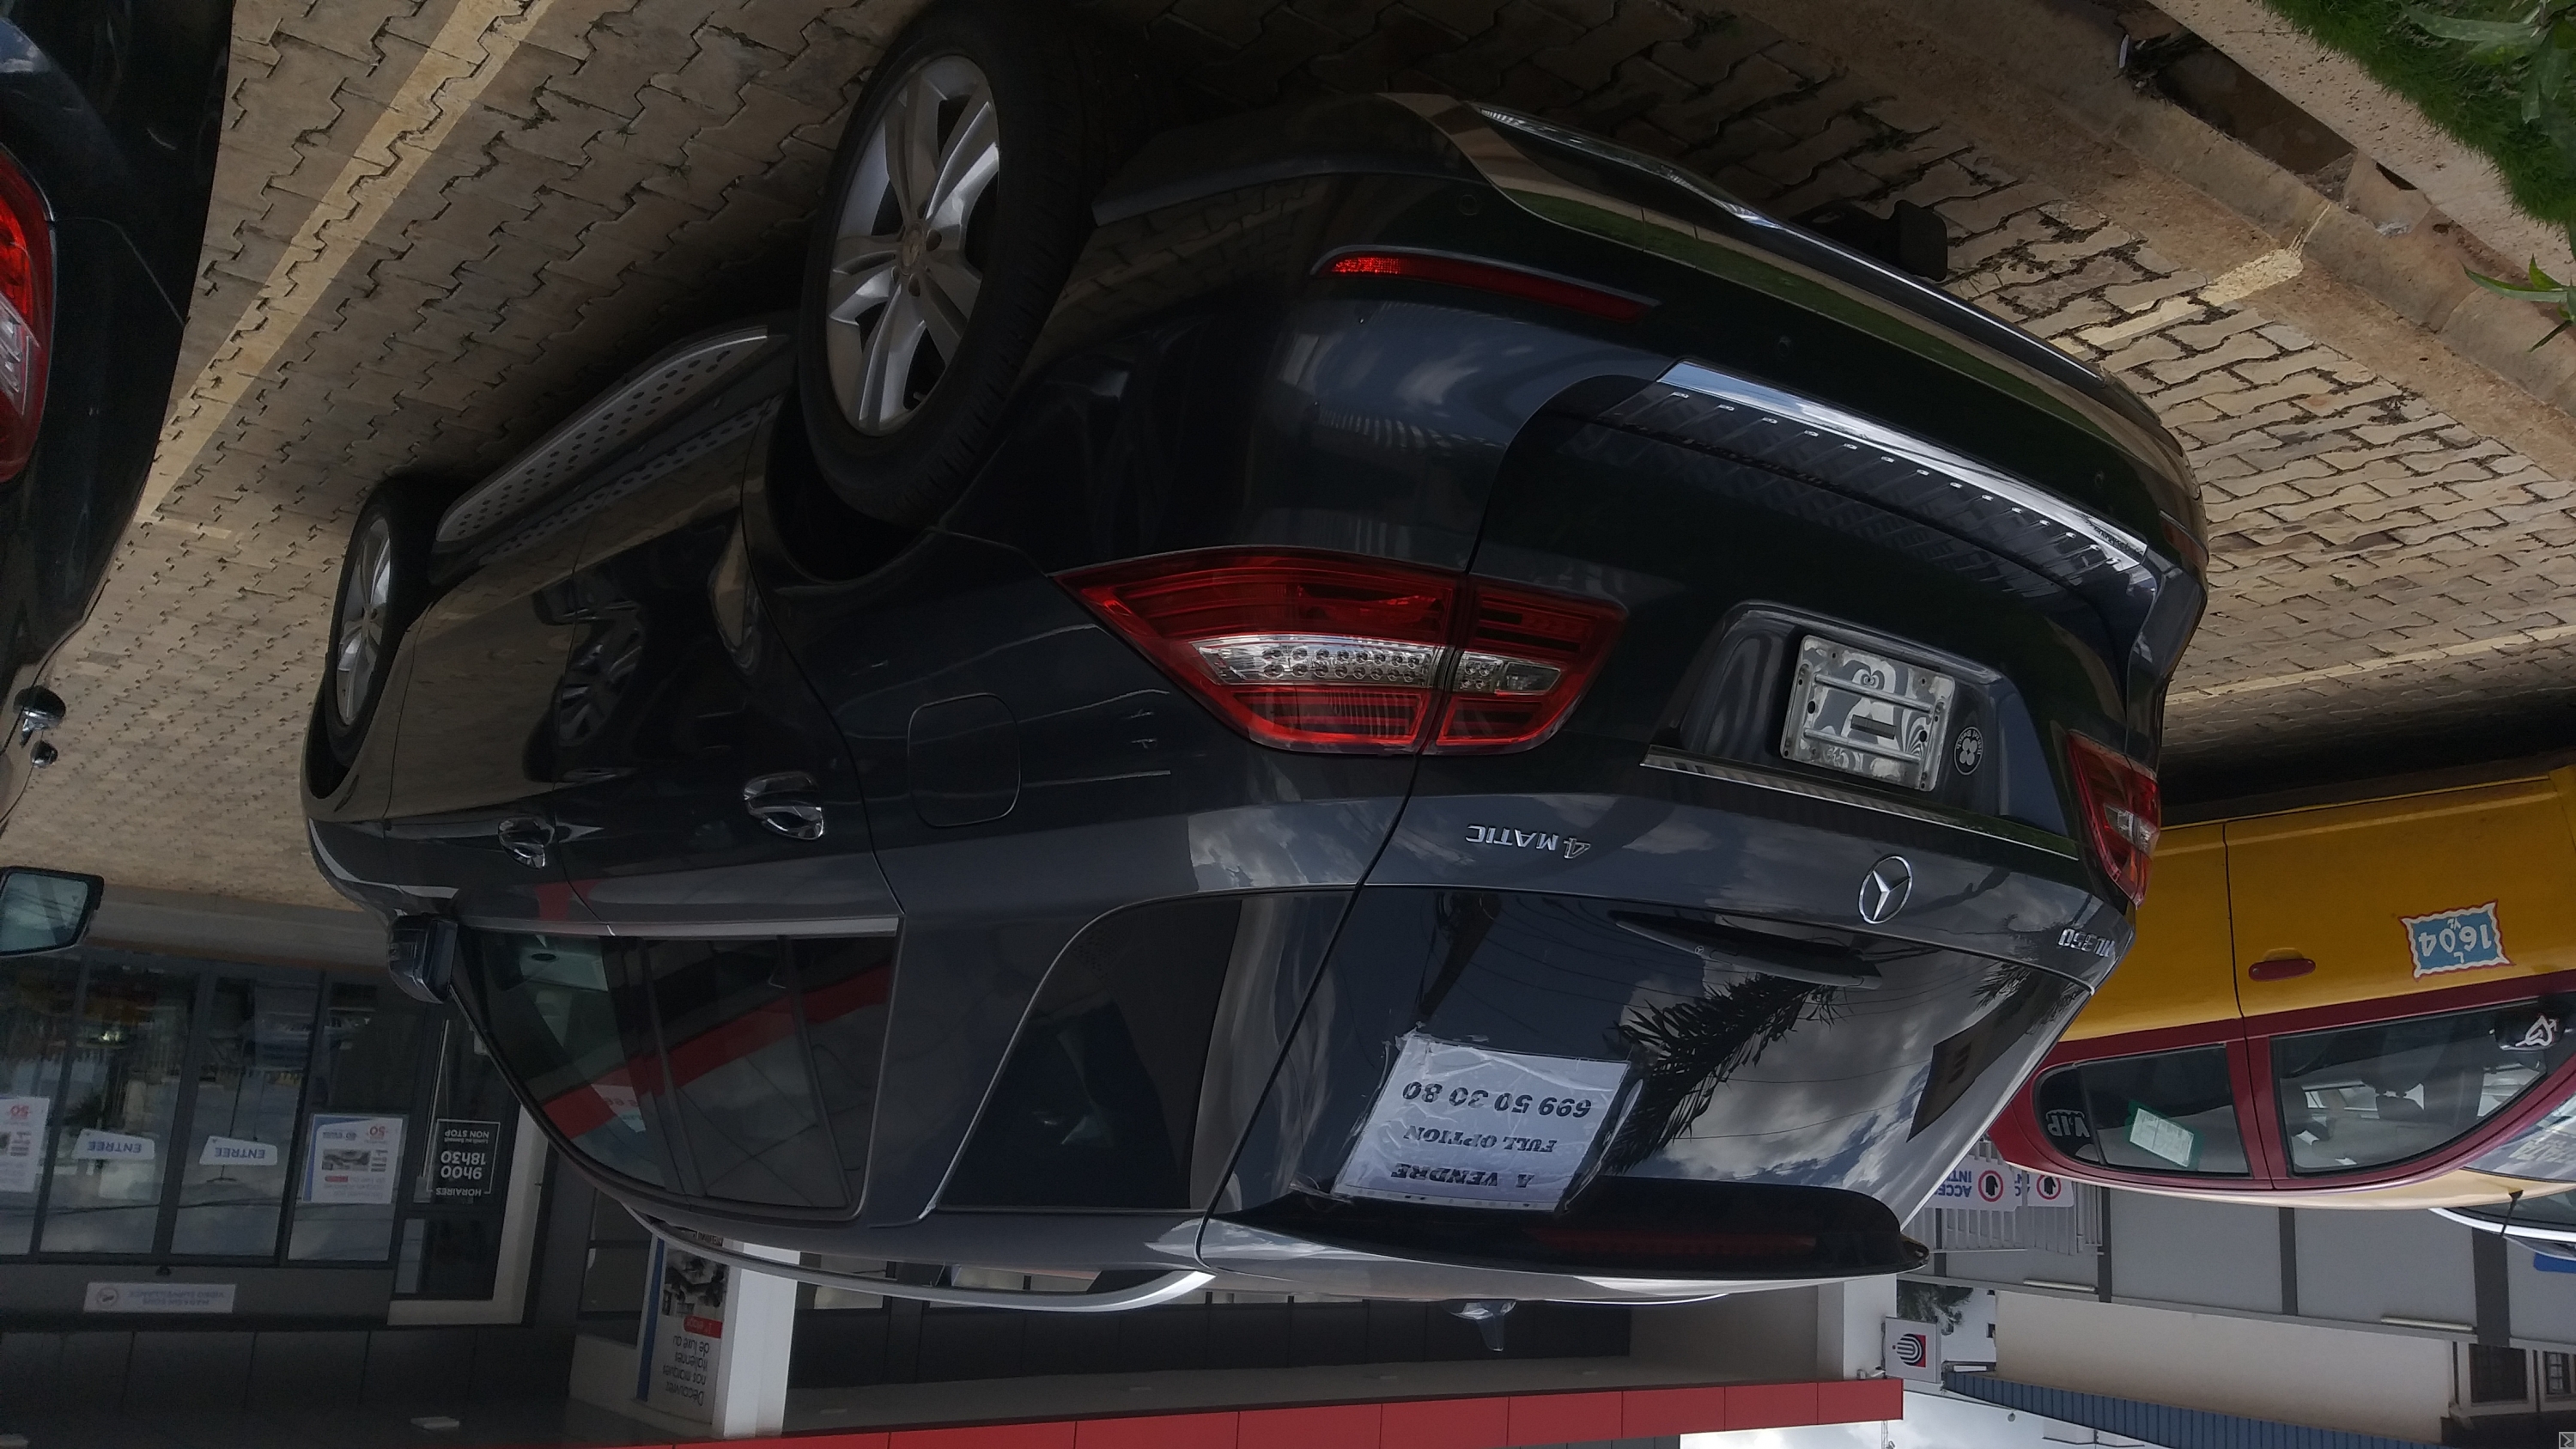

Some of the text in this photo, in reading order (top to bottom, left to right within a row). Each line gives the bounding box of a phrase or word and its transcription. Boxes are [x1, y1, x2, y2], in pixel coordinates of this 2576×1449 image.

[2418, 924, 2492, 957] 1604
[1401, 1081, 1592, 1118] 699 50 30 80
[445, 1129, 467, 1137] STOP
[1403, 1125, 1558, 1153] FULL OPTION
[88, 1141, 143, 1153] ENTREE
[215, 1148, 266, 1160] ENTREE
[440, 1151, 486, 1165] 18h30
[440, 1165, 483, 1180] 9h00
[1390, 1163, 1535, 1189] A VENDRE
[436, 1187, 482, 1196] HORAIRES
[673, 1336, 709, 1357] de luxe au
[692, 1373, 706, 1385] nos
